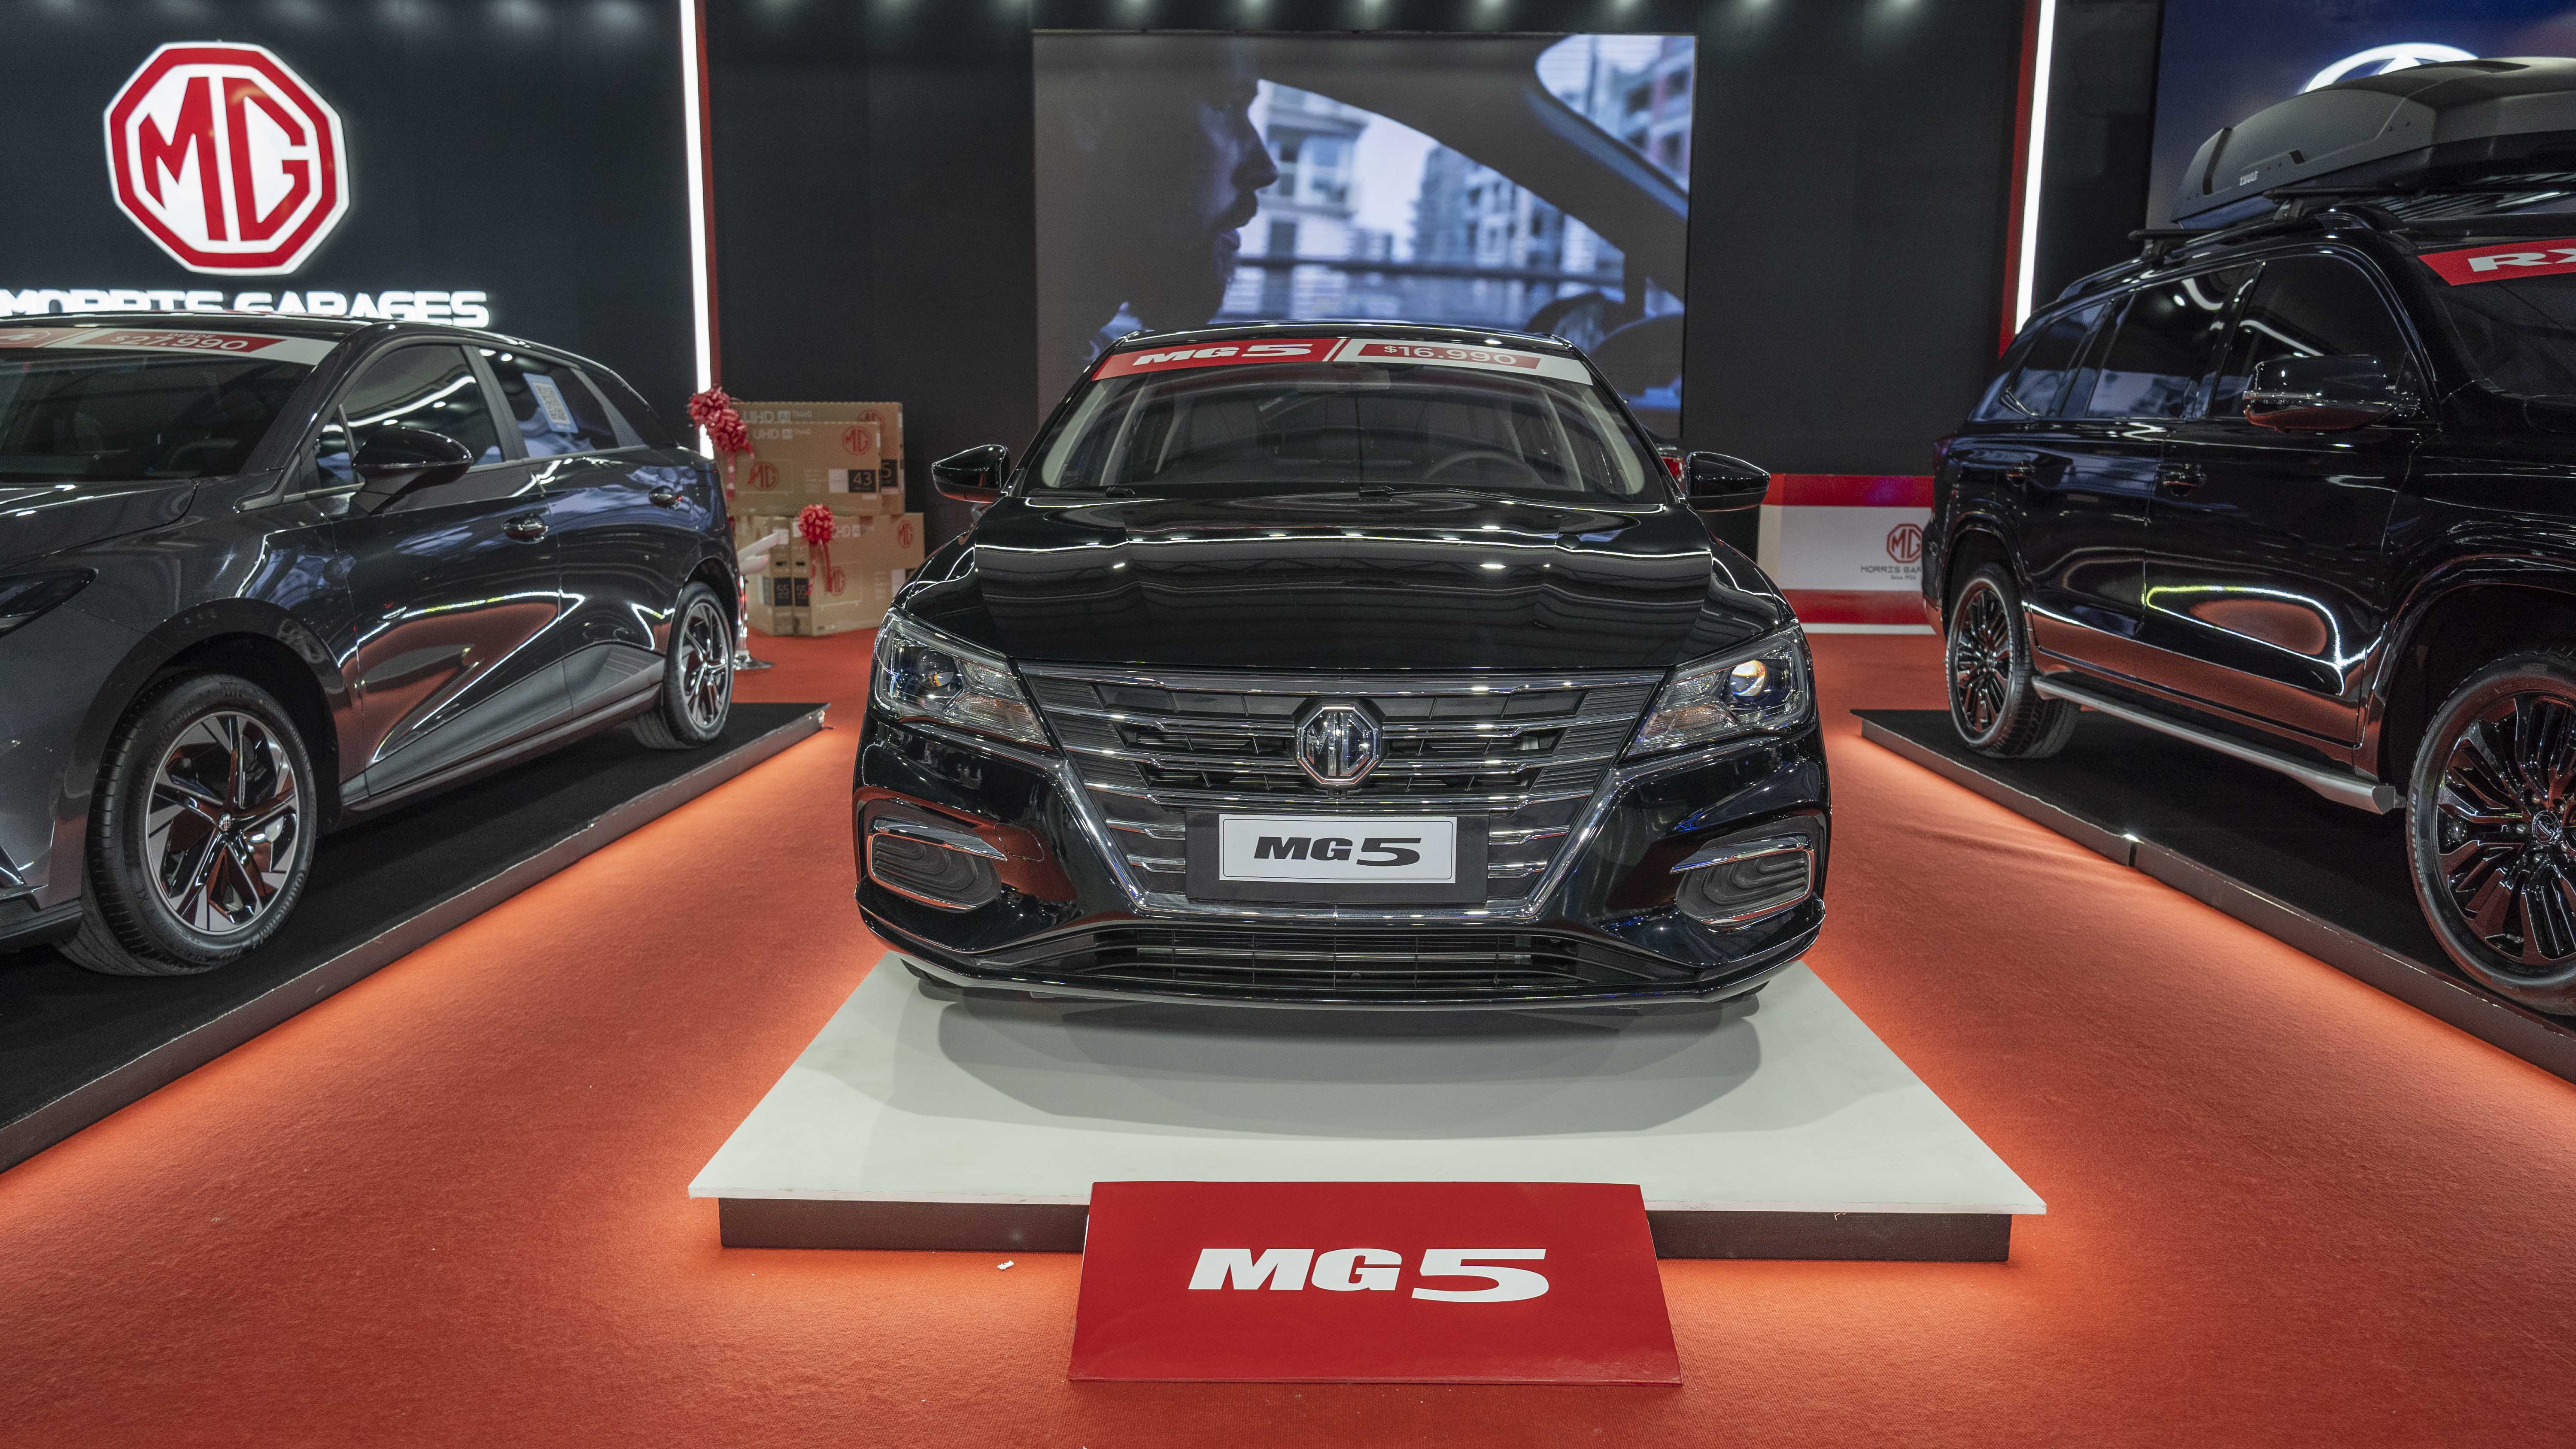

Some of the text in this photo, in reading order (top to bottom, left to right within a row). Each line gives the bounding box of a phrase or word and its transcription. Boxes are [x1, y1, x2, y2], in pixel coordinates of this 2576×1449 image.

[139, 76, 310, 242] MG
[110, 336, 249, 350] $27.990
[1133, 344, 1313, 366] MG5
[1384, 346, 1517, 365] $16.990
[852, 471, 872, 486] 43
[1891, 528, 1921, 558] MG
[1860, 565, 1901, 573] MORRIS
[1306, 710, 1373, 777] MG
[1254, 837, 1422, 867] MG5
[1187, 1247, 1550, 1303] MG5
